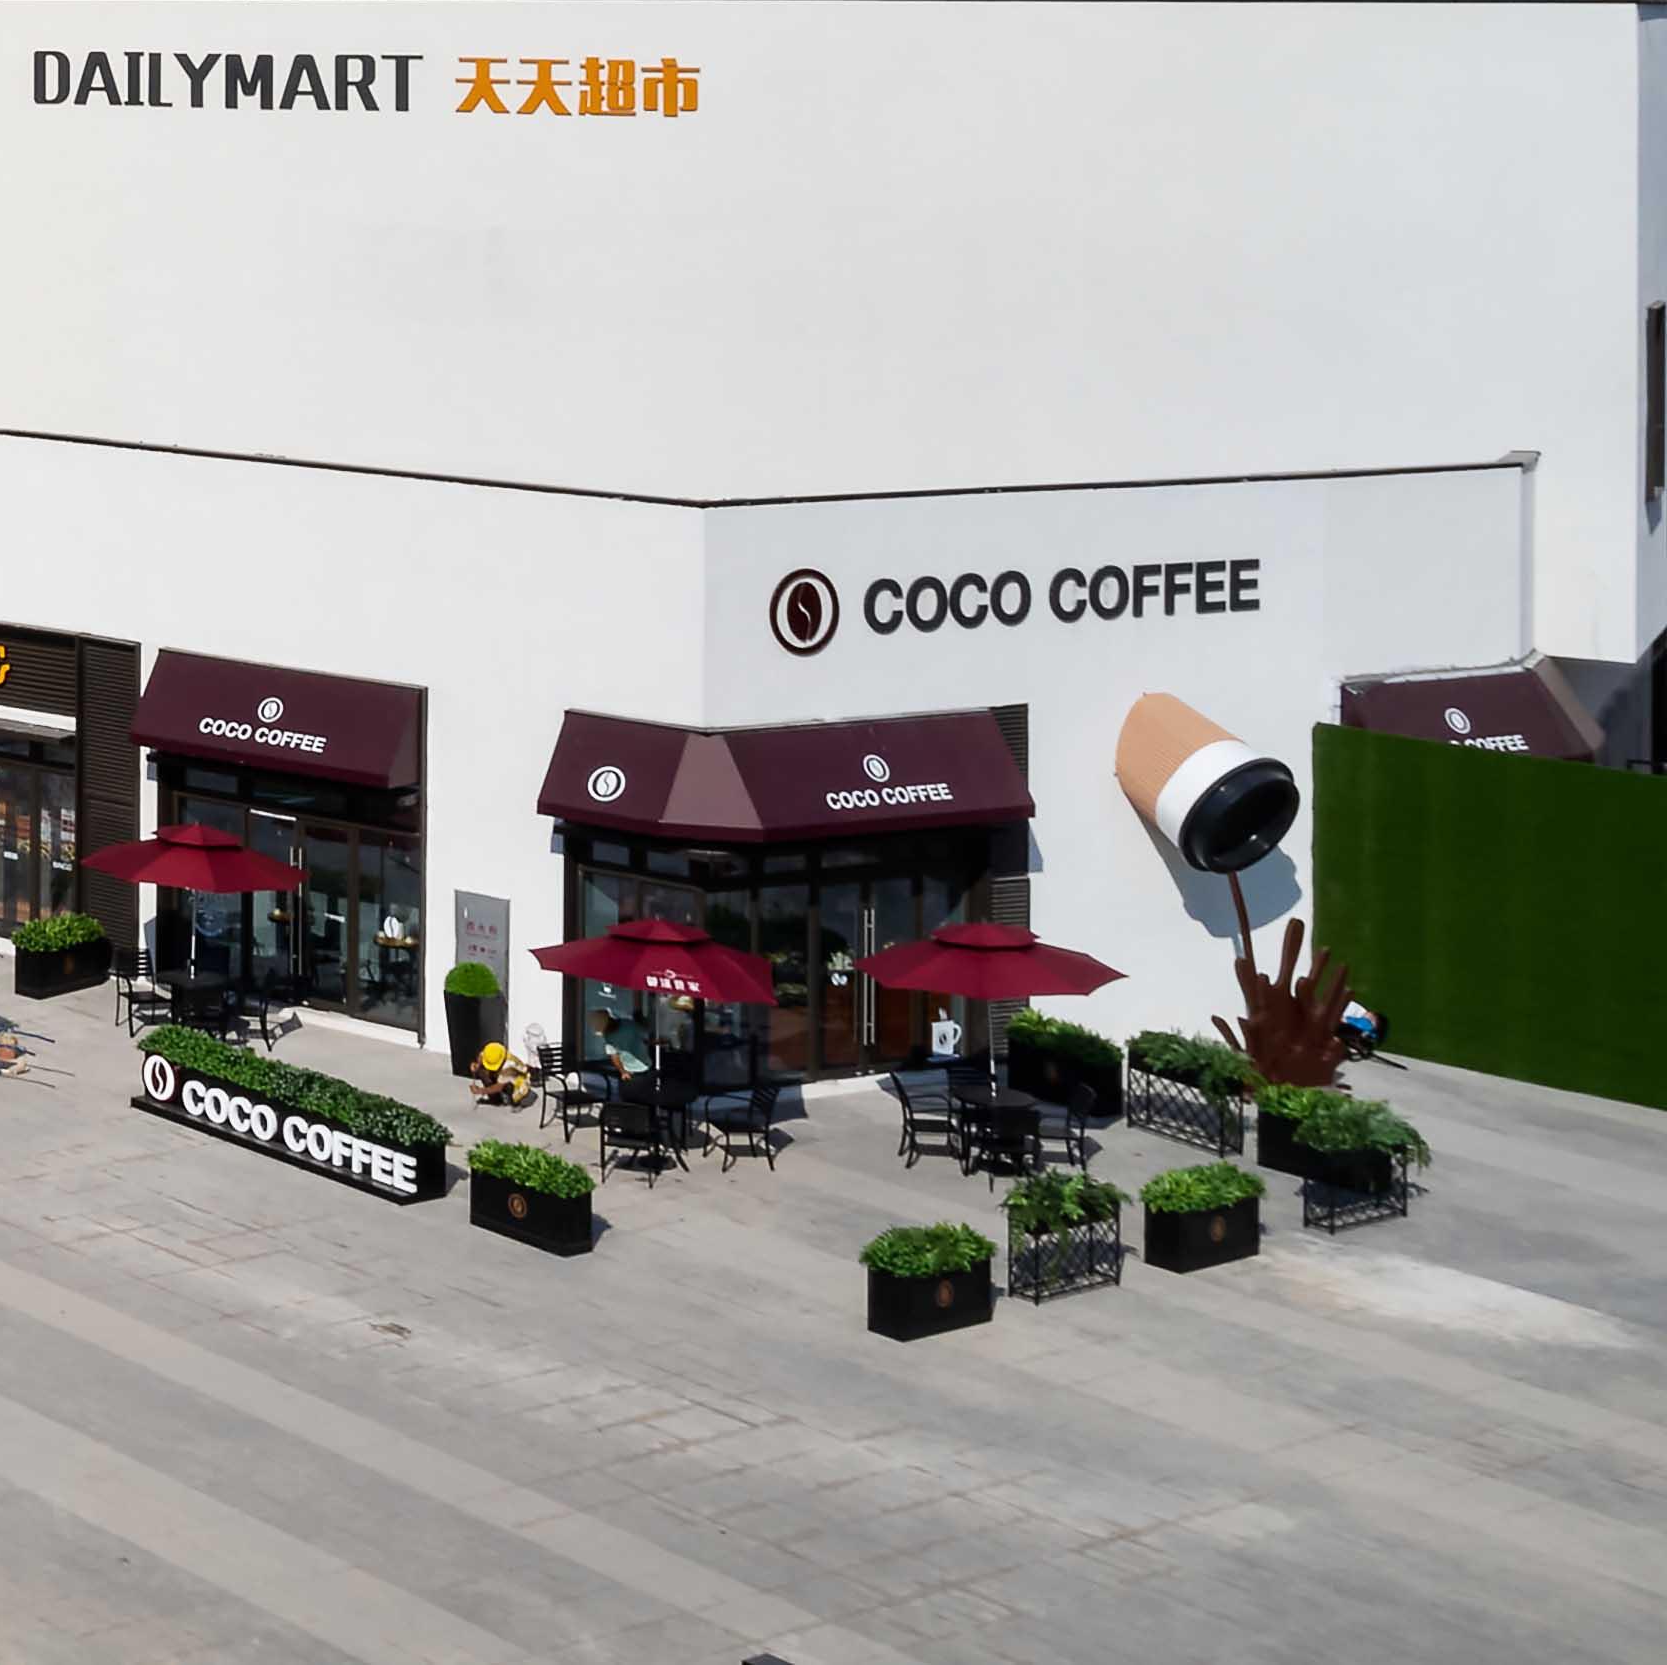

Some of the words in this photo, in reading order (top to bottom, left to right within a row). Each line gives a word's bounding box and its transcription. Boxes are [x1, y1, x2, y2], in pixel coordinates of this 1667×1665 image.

[33, 50, 424, 112] DAILYMART
[455, 56, 701, 117] 天天超市
[863, 570, 1032, 635] COCO
[1048, 558, 1261, 624] COFFEE
[199, 717, 253, 741] COCO
[255, 727, 327, 753] COFFEE
[826, 789, 880, 810] COCO
[881, 782, 954, 805] COFFEE
[181, 1079, 278, 1142] COCO
[282, 1115, 418, 1194] COFFEE
